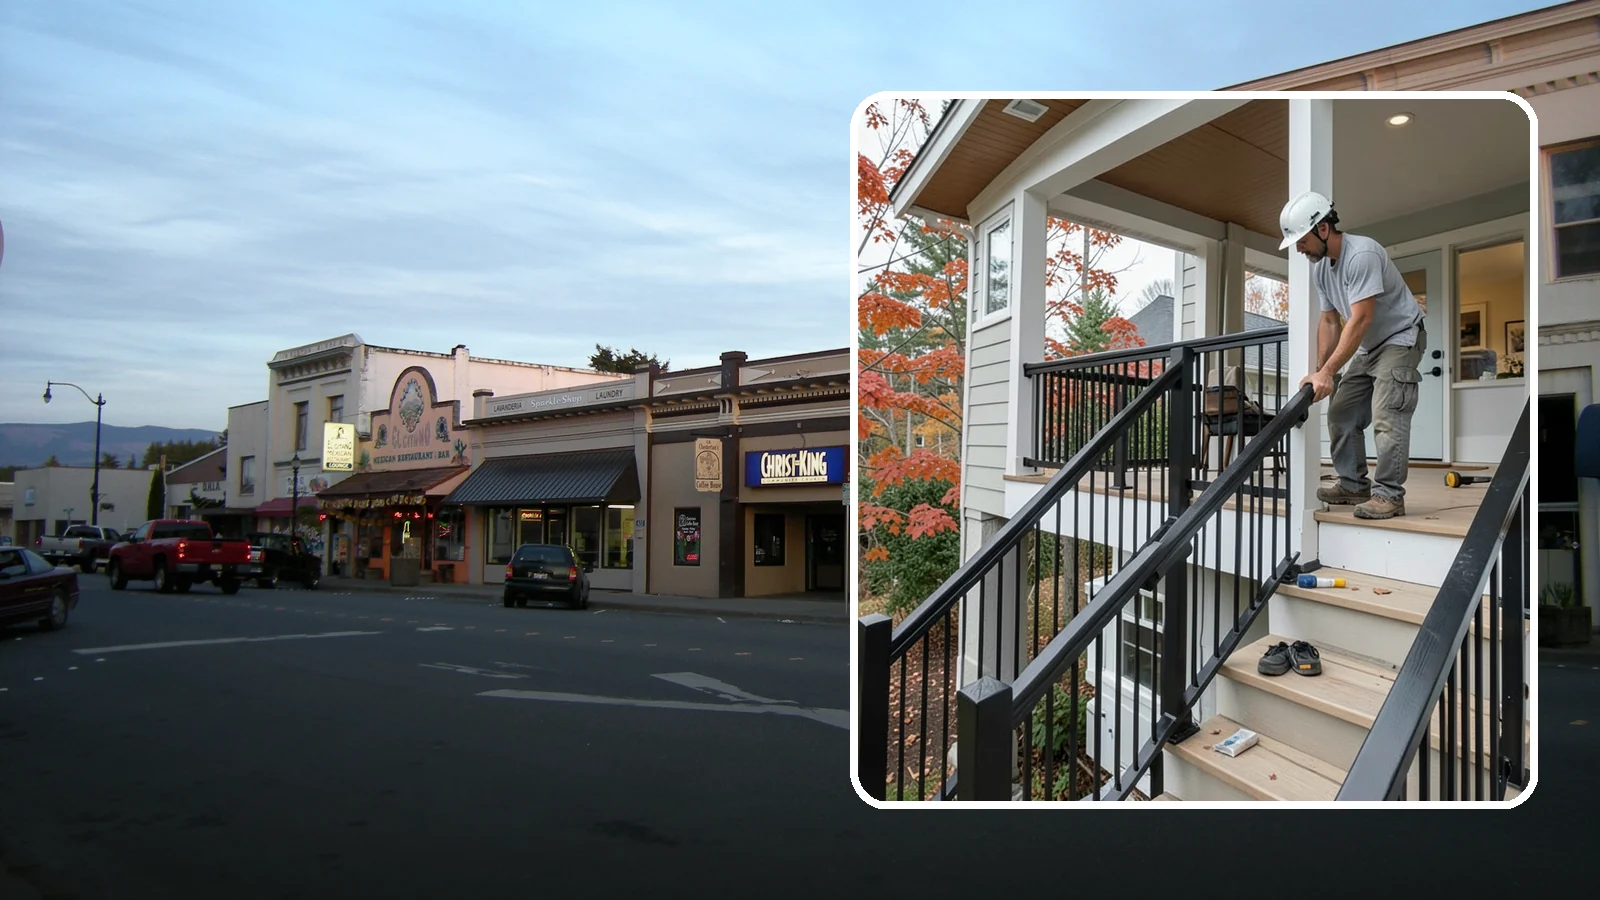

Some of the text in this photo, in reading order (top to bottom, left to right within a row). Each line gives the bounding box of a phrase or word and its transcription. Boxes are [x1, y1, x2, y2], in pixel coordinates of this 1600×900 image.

[493, 389, 624, 412] LAVANDERIA Sparkle Shop LAUNDRY
[373, 454, 396, 464] MEXICAN
[397, 451, 433, 462] RESTAURANT
[438, 450, 450, 459] BAR
[760, 450, 827, 478] CHRIST KING
